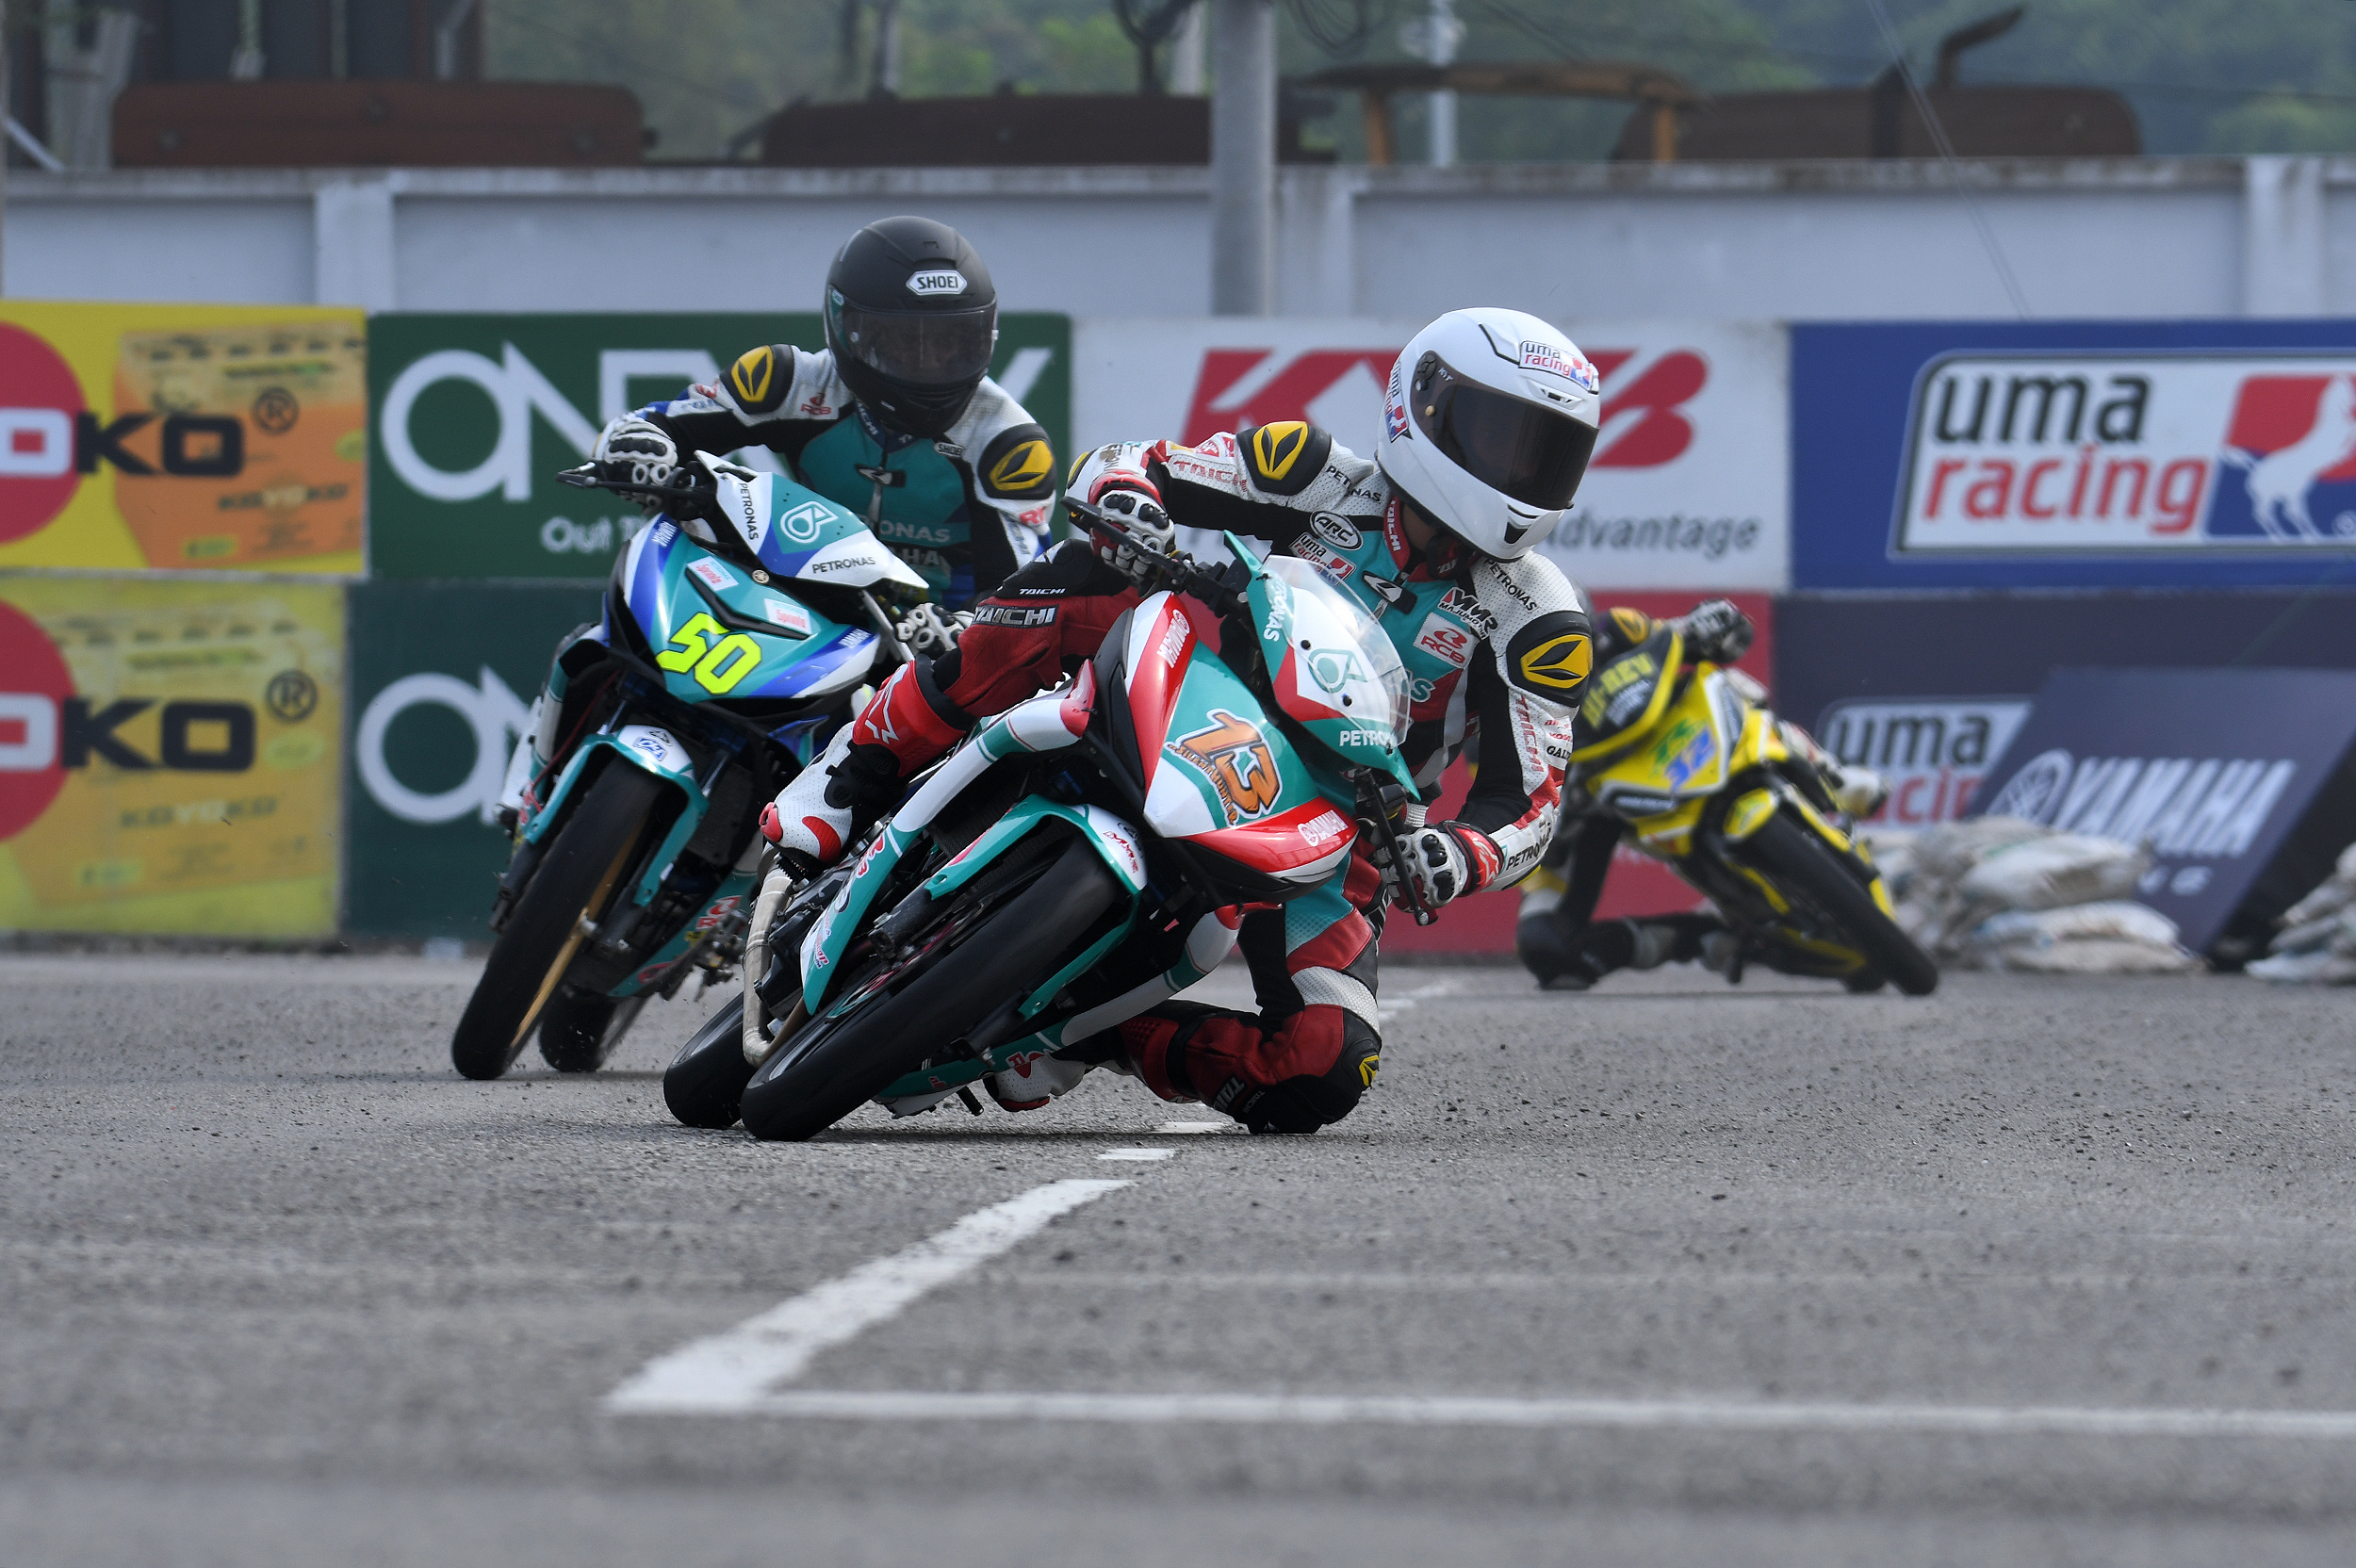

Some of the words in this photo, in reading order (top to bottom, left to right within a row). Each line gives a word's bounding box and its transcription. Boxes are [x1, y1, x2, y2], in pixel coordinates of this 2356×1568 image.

[918, 275, 958, 290] SHOEI
[1524, 352, 1571, 376] racing
[1525, 342, 1561, 359] uma
[1932, 374, 2151, 445] uma
[1922, 445, 2211, 535] racing
[738, 482, 760, 541] PETRONAS
[1316, 515, 1354, 543] ARC
[540, 516, 612, 553] Out
[1301, 534, 1327, 558] uma
[1546, 507, 1761, 562] dvantage
[811, 556, 876, 574] PETRONAS
[1484, 557, 1537, 612] PETRONAS
[973, 606, 1056, 626] TAICHI
[656, 611, 762, 695] 50
[1420, 634, 1466, 664] RCB
[1832, 712, 1992, 768] uma
[1176, 709, 1283, 819] 13
